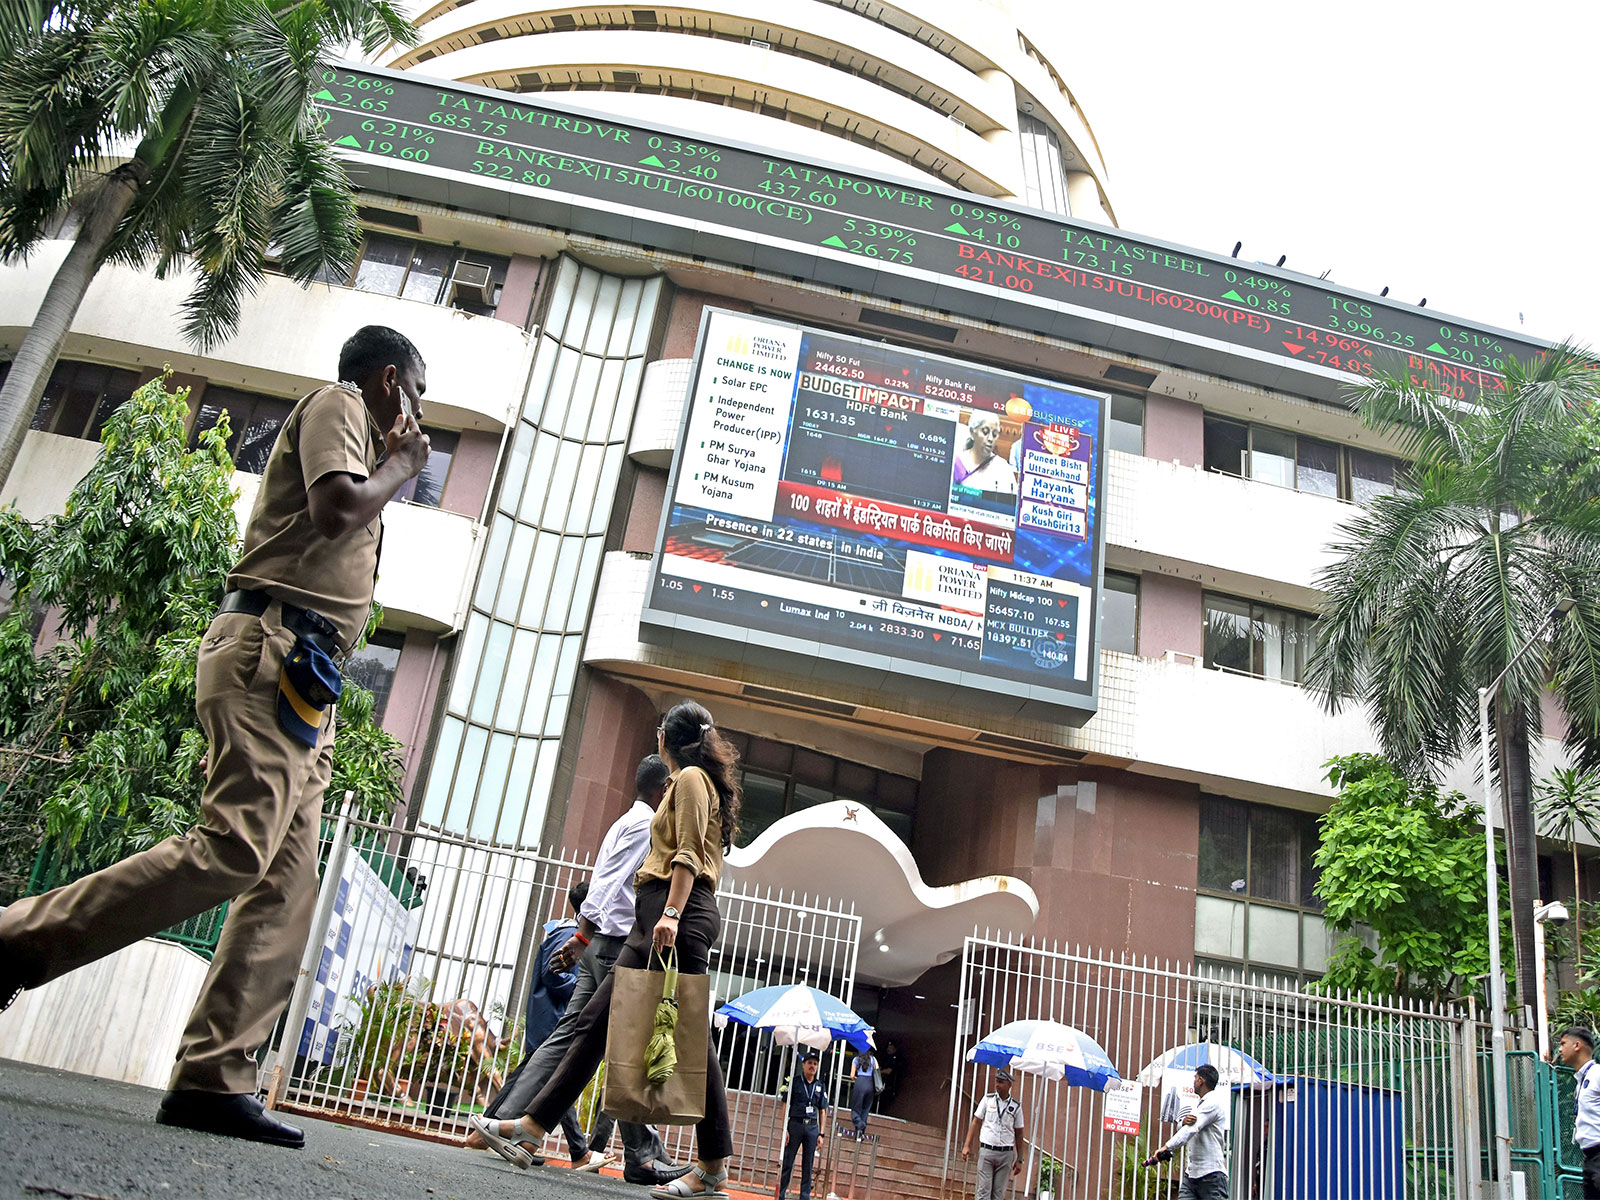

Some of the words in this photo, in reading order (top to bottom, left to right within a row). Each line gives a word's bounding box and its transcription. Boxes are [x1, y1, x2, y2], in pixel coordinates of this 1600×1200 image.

[322, 71, 394, 95] 0.26%
[337, 93, 389, 112] 2.65
[428, 111, 508, 137] 685.75
[436, 92, 631, 144] TATAMTRDVR
[360, 119, 435, 145] 6.21%
[366, 139, 430, 163] 19.60
[647, 135, 721, 162] 0.35%
[470, 160, 551, 188] 522.80
[665, 158, 718, 181] 2.40
[476, 140, 813, 225] BANKEX|15JUL|60100(CE)
[757, 179, 837, 207] 437.60
[762, 160, 935, 211] TATAPOWER
[950, 202, 1022, 231] 0.95%
[842, 218, 917, 247] 5.39%
[970, 227, 1021, 249] 4.10
[849, 238, 914, 265] 26.75
[1060, 229, 1210, 278] TATASTEEL
[1061, 248, 1133, 276] 173.15
[954, 263, 1034, 293] 421.00
[958, 244, 1271, 334] BANKEX|15JUL|60200(PE)
[1224, 270, 1292, 298] 0.49%
[1246, 294, 1291, 316] 0.85
[1326, 295, 1373, 319] TCS
[1285, 327, 1373, 357] -14.96%
[1328, 315, 1416, 348] 3,996.25
[1439, 326, 1503, 353] 0.51%
[816, 350, 834, 362] Nifty
[836, 354, 847, 363] 50
[1307, 350, 1373, 376] -74.05
[1450, 346, 1504, 370] 20.30
[716, 357, 755, 373] CHANGE
[757, 365, 767, 375] IS
[769, 368, 792, 380] NOW
[814, 361, 865, 380] 24462.50
[721, 375, 746, 389] Solar
[749, 381, 768, 393] EPC
[884, 377, 909, 390] 0.22%
[925, 374, 943, 386] Nifty
[945, 378, 962, 389] Bank
[801, 374, 860, 399] BUDGET
[862, 387, 920, 412] IMPACT
[925, 385, 973, 403] 52200.35
[715, 407, 746, 422] Power
[717, 395, 775, 416] Independent
[846, 401, 877, 415] HDFC
[880, 407, 908, 421] Bank
[805, 407, 856, 427] 1631.35
[713, 420, 782, 444] Producer(IPP)
[919, 432, 947, 445] 0.68%
[1054, 425, 1074, 436] LIVE
[709, 440, 725, 450] PM
[728, 443, 756, 458] Surya
[706, 453, 730, 467] Ghar
[734, 458, 766, 474] Yojana
[1028, 451, 1058, 466] Puneet
[1060, 457, 1082, 471] Bisht
[703, 471, 719, 482] PM
[721, 475, 755, 490] Kusum
[1028, 463, 1081, 482] Uttarakhand
[701, 485, 733, 500] Yojana
[1031, 487, 1075, 505] Haryana
[1033, 478, 1074, 495] Mayank
[790, 493, 810, 512] 100
[842, 499, 853, 521] में
[899, 512, 921, 534] पार्क
[922, 517, 962, 543] विकसित
[962, 522, 983, 549] किए
[1022, 513, 1081, 533] @KushGiri13
[1032, 504, 1054, 517] Kush
[1056, 509, 1073, 521] Giri
[706, 513, 759, 535] Presence
[762, 525, 773, 537] in
[776, 528, 794, 542] 22
[798, 533, 833, 550] states
[840, 540, 853, 554] in
[855, 544, 884, 561] India
[939, 564, 981, 580] ORIANA
[939, 574, 976, 589] POWER
[1013, 573, 1037, 586] 11:37
[1040, 578, 1053, 589] AM
[938, 584, 982, 600] LIMITED
[989, 586, 1007, 599] Nifty
[1009, 590, 1035, 605] Midcap
[1037, 596, 1053, 607] 100
[712, 588, 735, 601] 1.55
[780, 602, 812, 618] Lumax
[815, 609, 830, 621] Ind
[835, 610, 845, 619] 10
[880, 623, 924, 640] 2833.30
[951, 636, 980, 650] 71.65
[988, 604, 1035, 621] 56457.10
[1044, 616, 1071, 629] 167.55
[987, 619, 1006, 631] MCX
[1008, 622, 1049, 638] BULLDEX
[1036, 1043, 1064, 1053] BSE
